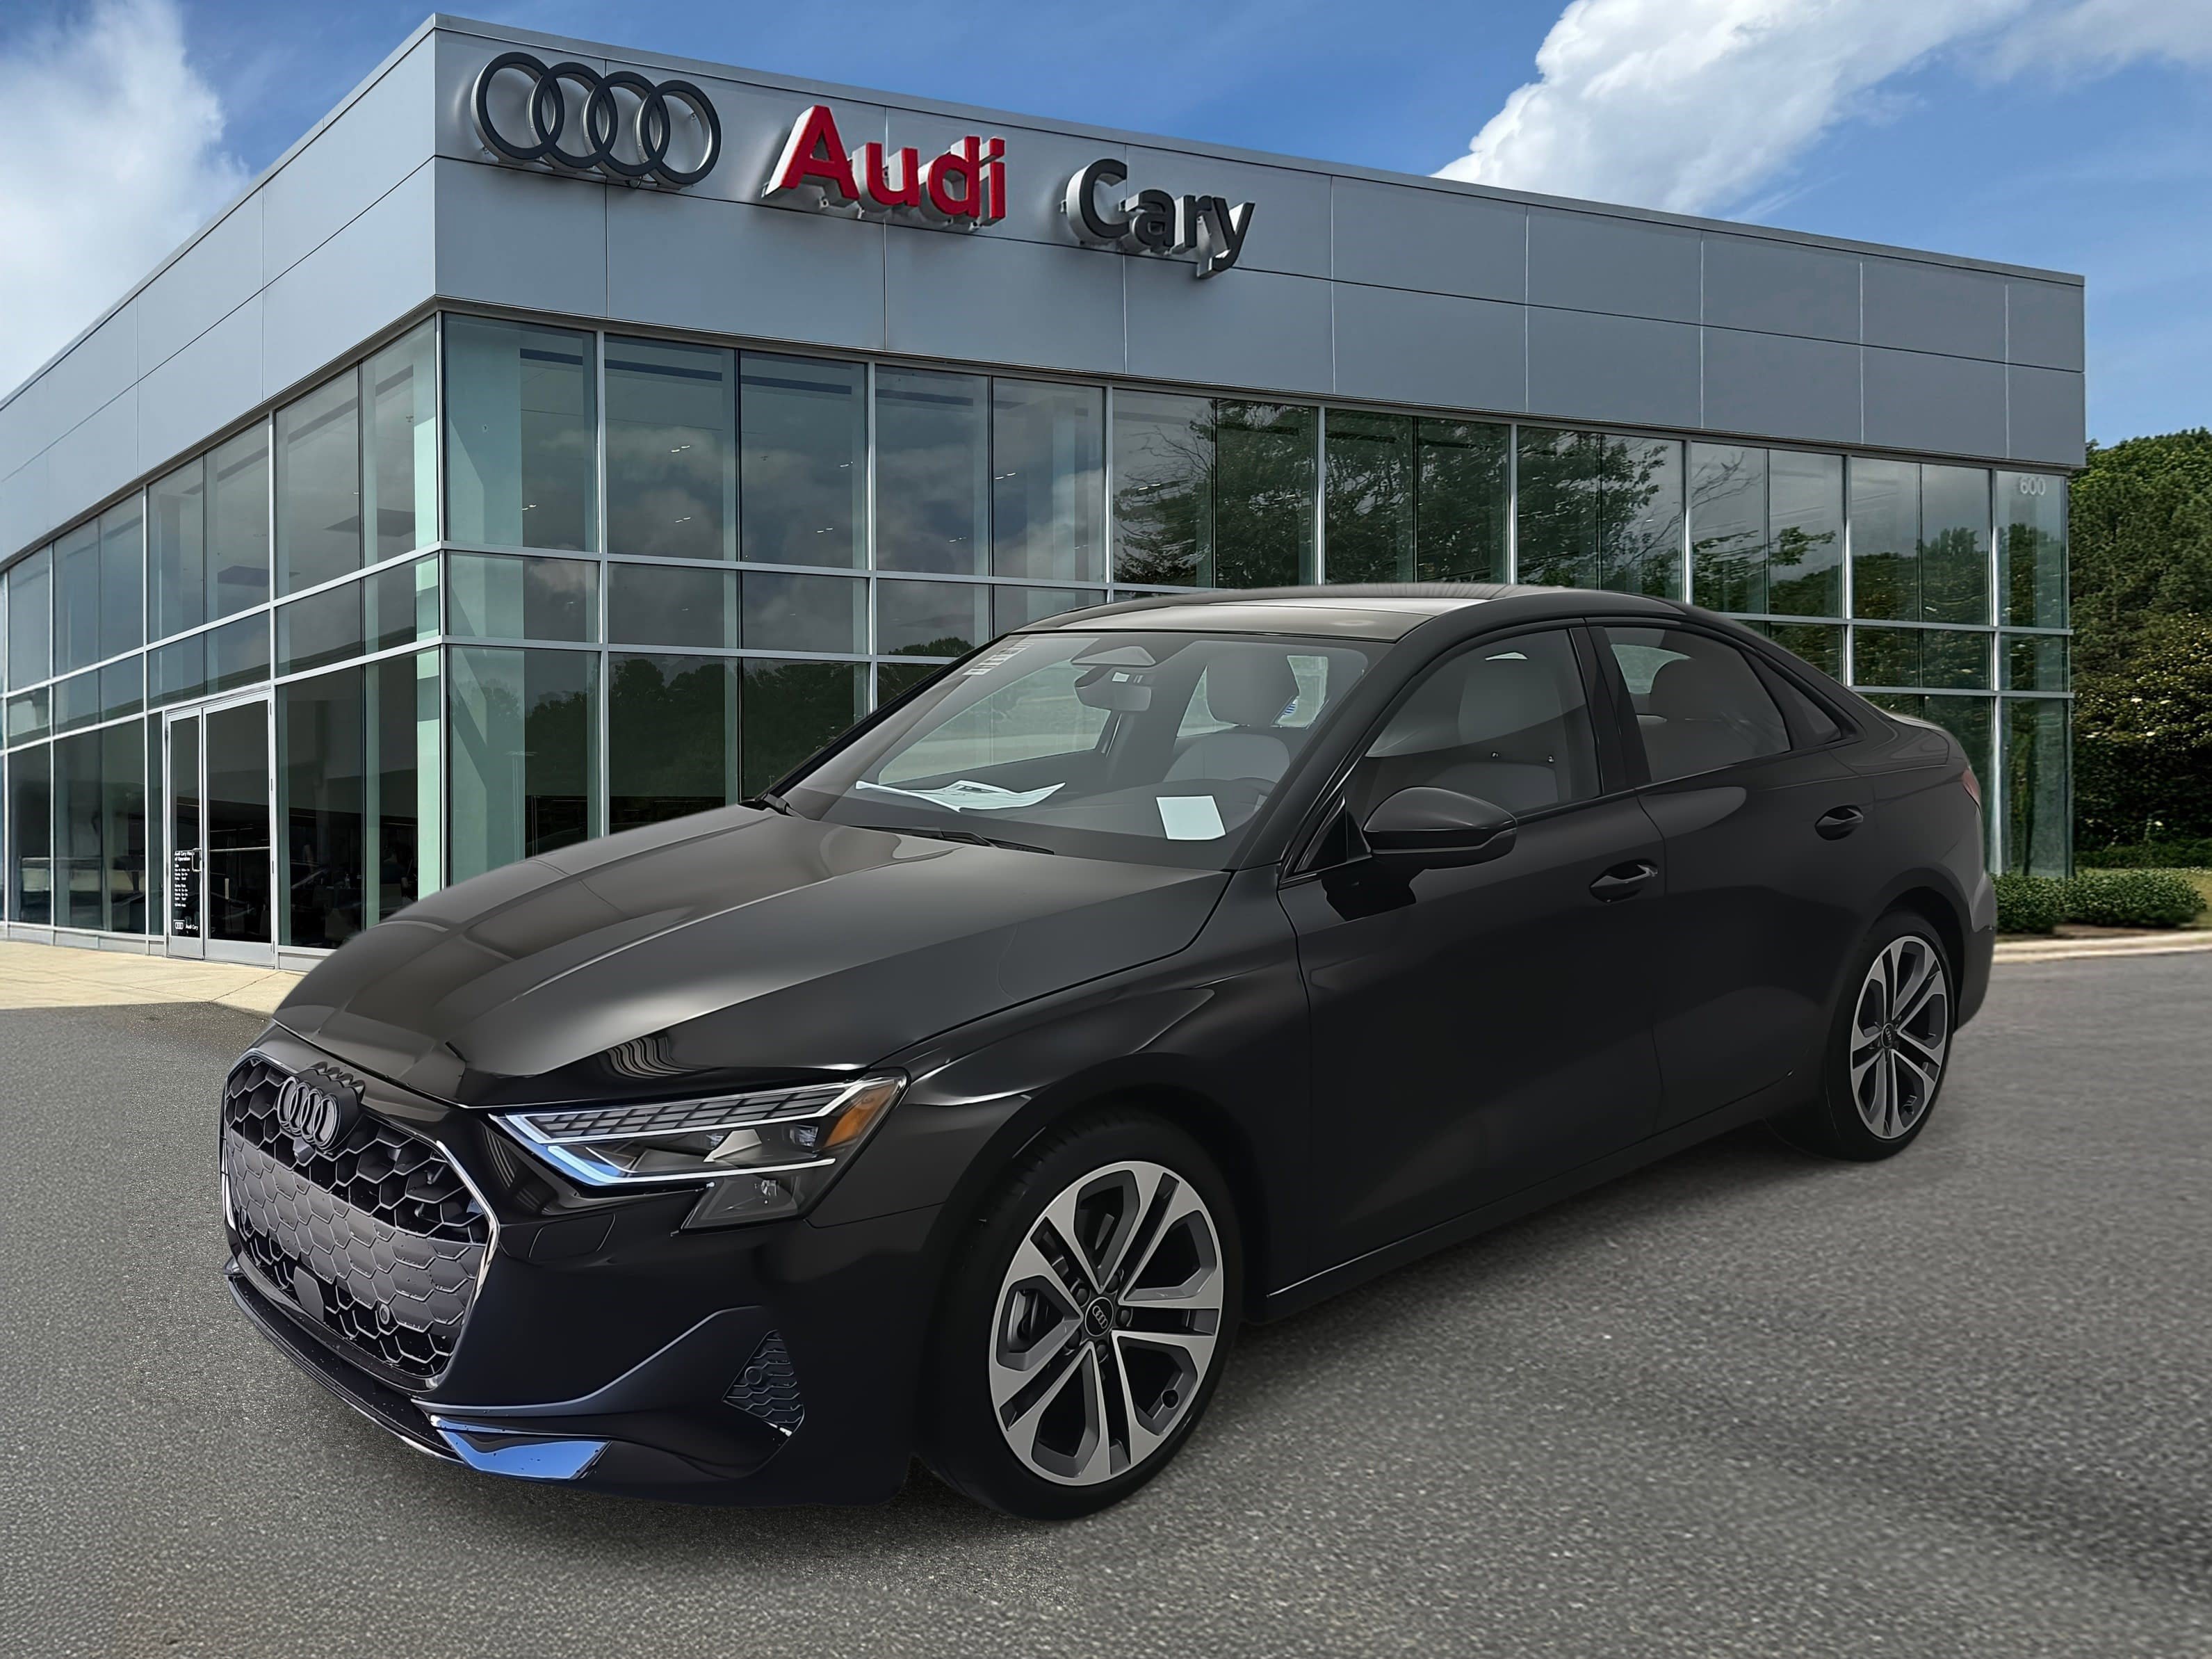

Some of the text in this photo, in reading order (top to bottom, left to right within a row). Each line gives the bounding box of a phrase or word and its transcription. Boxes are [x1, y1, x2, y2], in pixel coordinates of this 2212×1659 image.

[764, 105, 1255, 277] Audi Cary
[2019, 476, 2045, 495] 600
